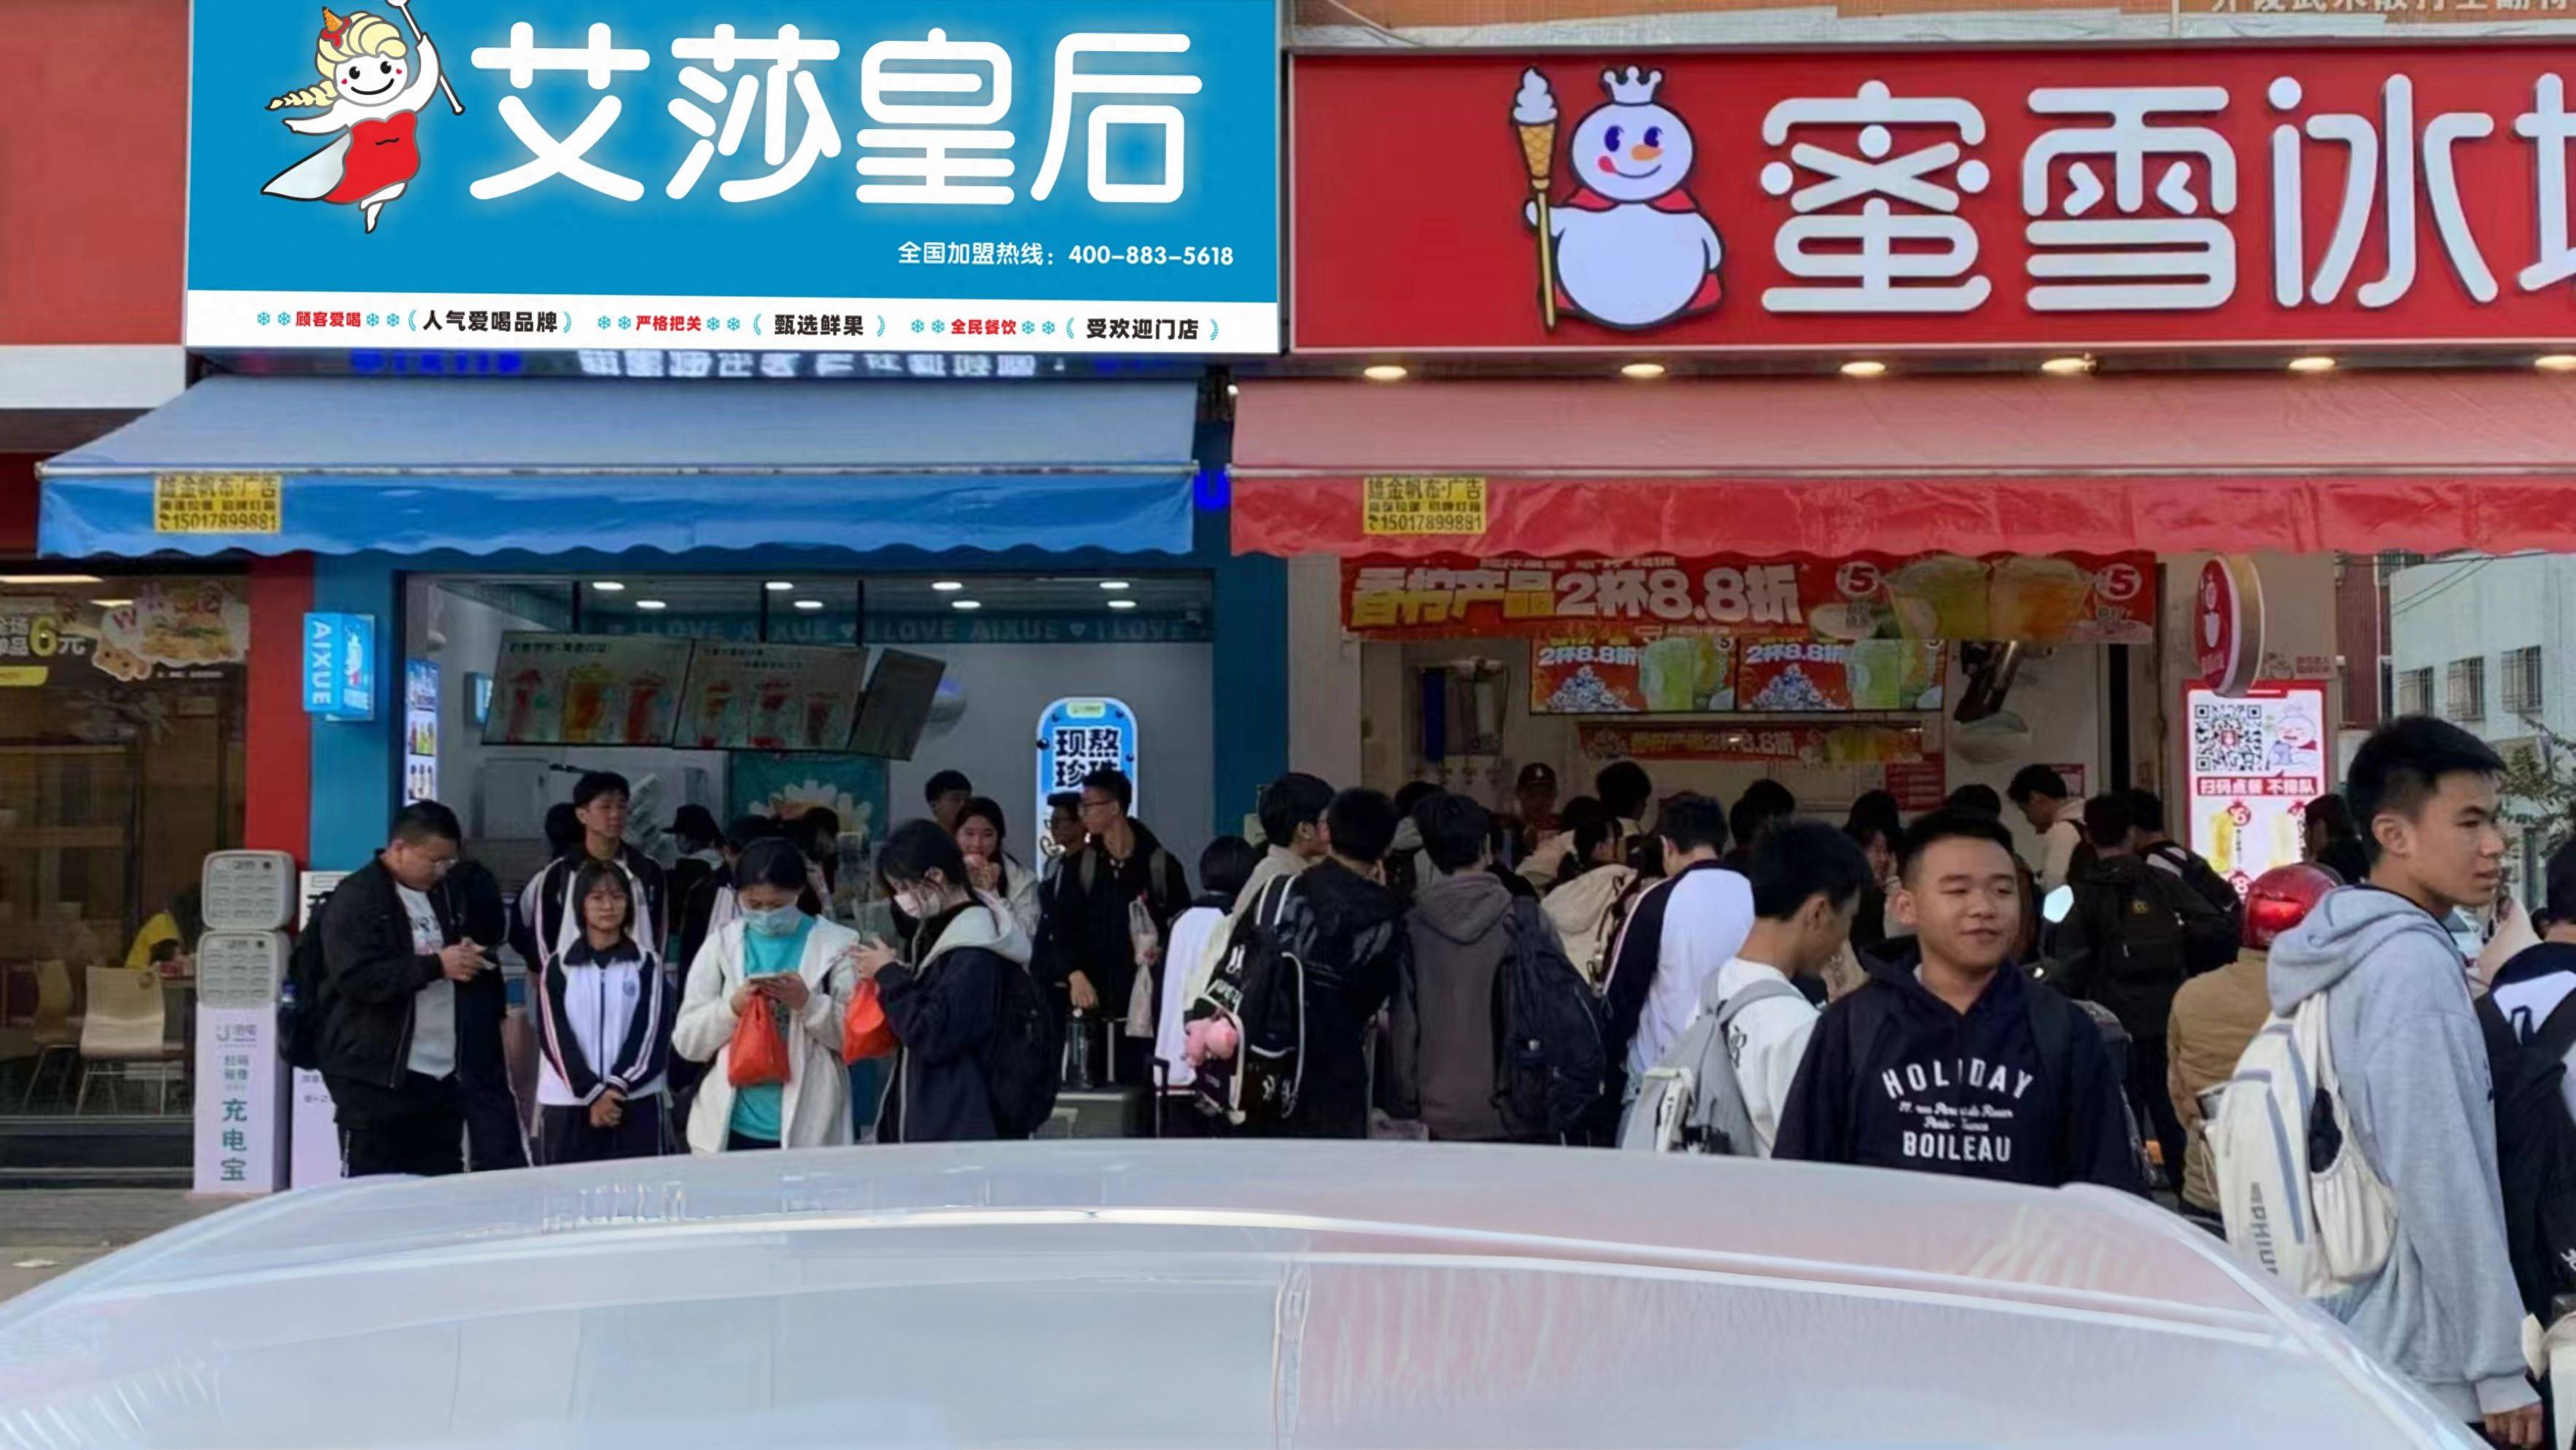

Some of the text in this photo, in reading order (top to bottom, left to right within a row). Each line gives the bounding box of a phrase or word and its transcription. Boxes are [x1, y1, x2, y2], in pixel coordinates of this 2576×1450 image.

[470, 22, 1203, 204] 艾莎皇后
[1068, 245, 1234, 266] 400-883-5618
[295, 310, 1198, 340] 顾客爱喝 人气爱喝品牌 严格把关 甄选鲜果 全民餐饮 受欢迎门店
[1380, 514, 1481, 531] 15017899881
[311, 620, 333, 705] AIXUE
[1055, 729, 1119, 758] 现熬
[1055, 760, 1118, 788] 珍
[1881, 1057, 2033, 1100] HOLIDAY
[220, 1097, 248, 1182] 充电宝
[1902, 1131, 2011, 1163] BOILEAU
